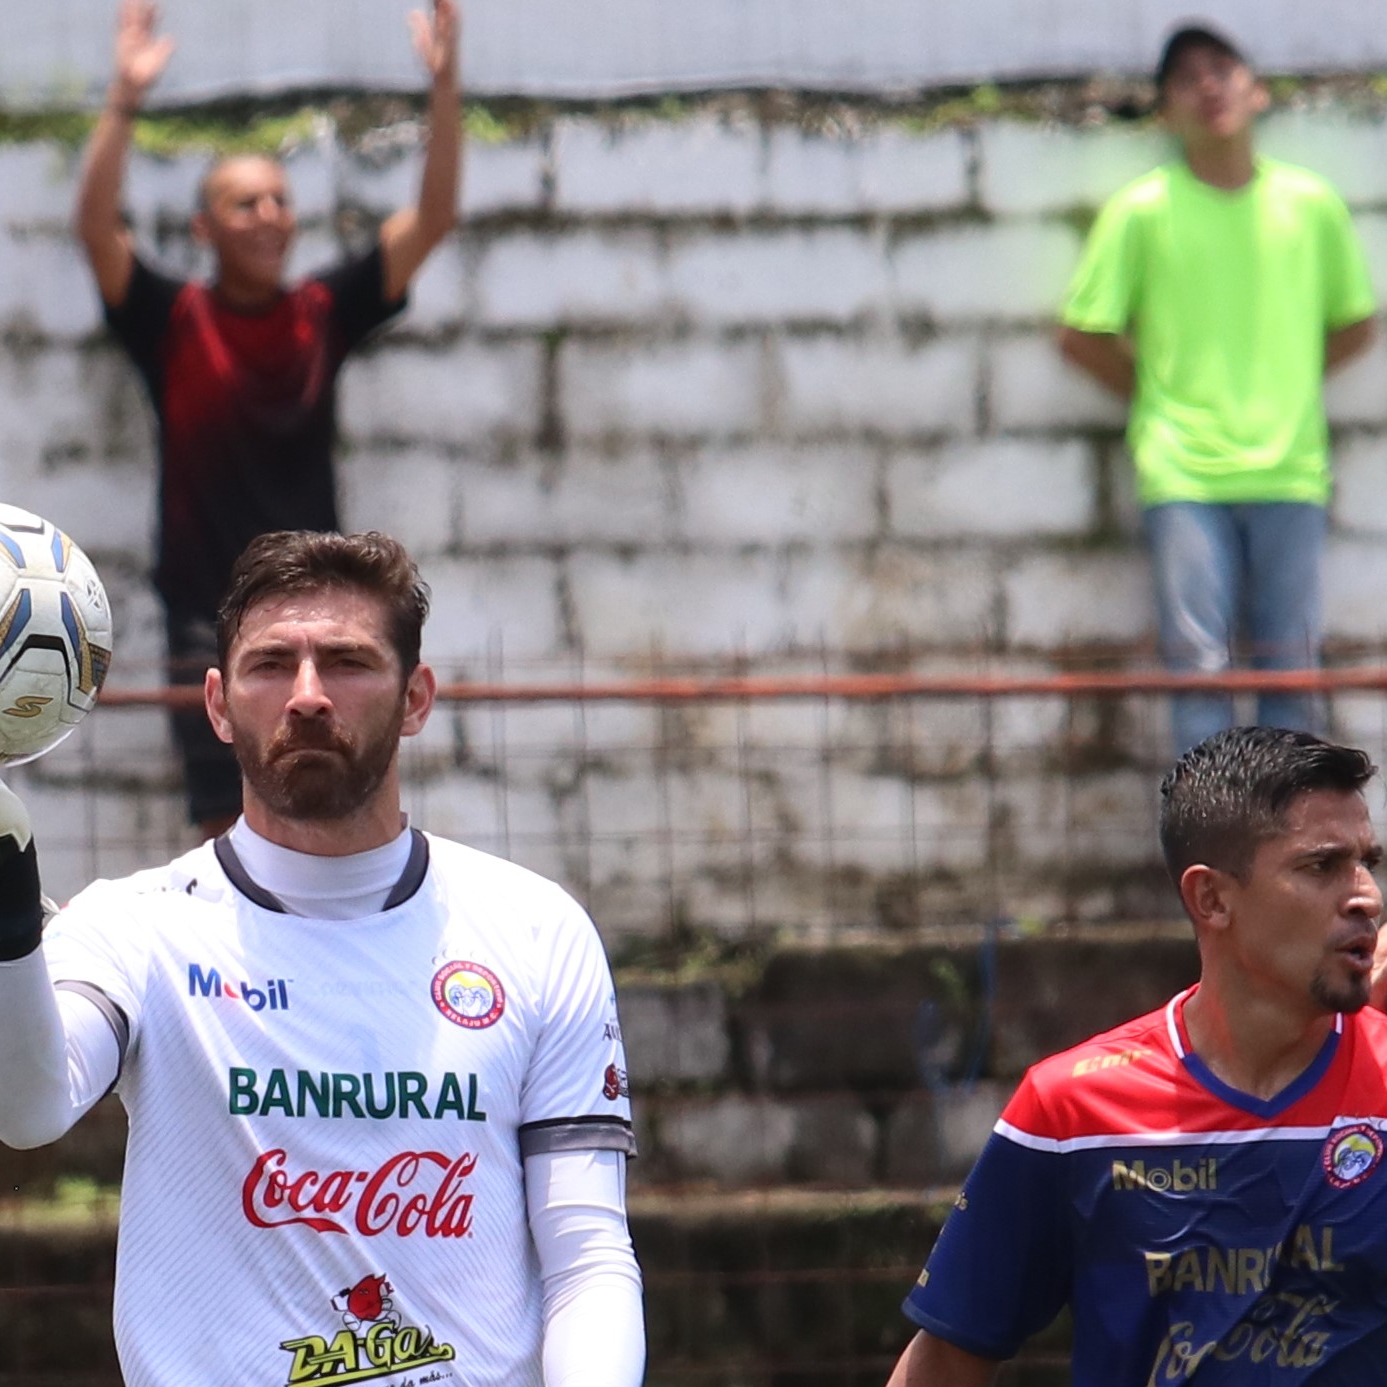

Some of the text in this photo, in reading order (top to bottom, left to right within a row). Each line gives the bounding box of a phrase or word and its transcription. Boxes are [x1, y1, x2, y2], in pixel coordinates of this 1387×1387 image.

[229, 1067, 486, 1121] BANRURAL
[242, 1148, 479, 1238] Coca-Cola
[1112, 1158, 1218, 1191] Mobil
